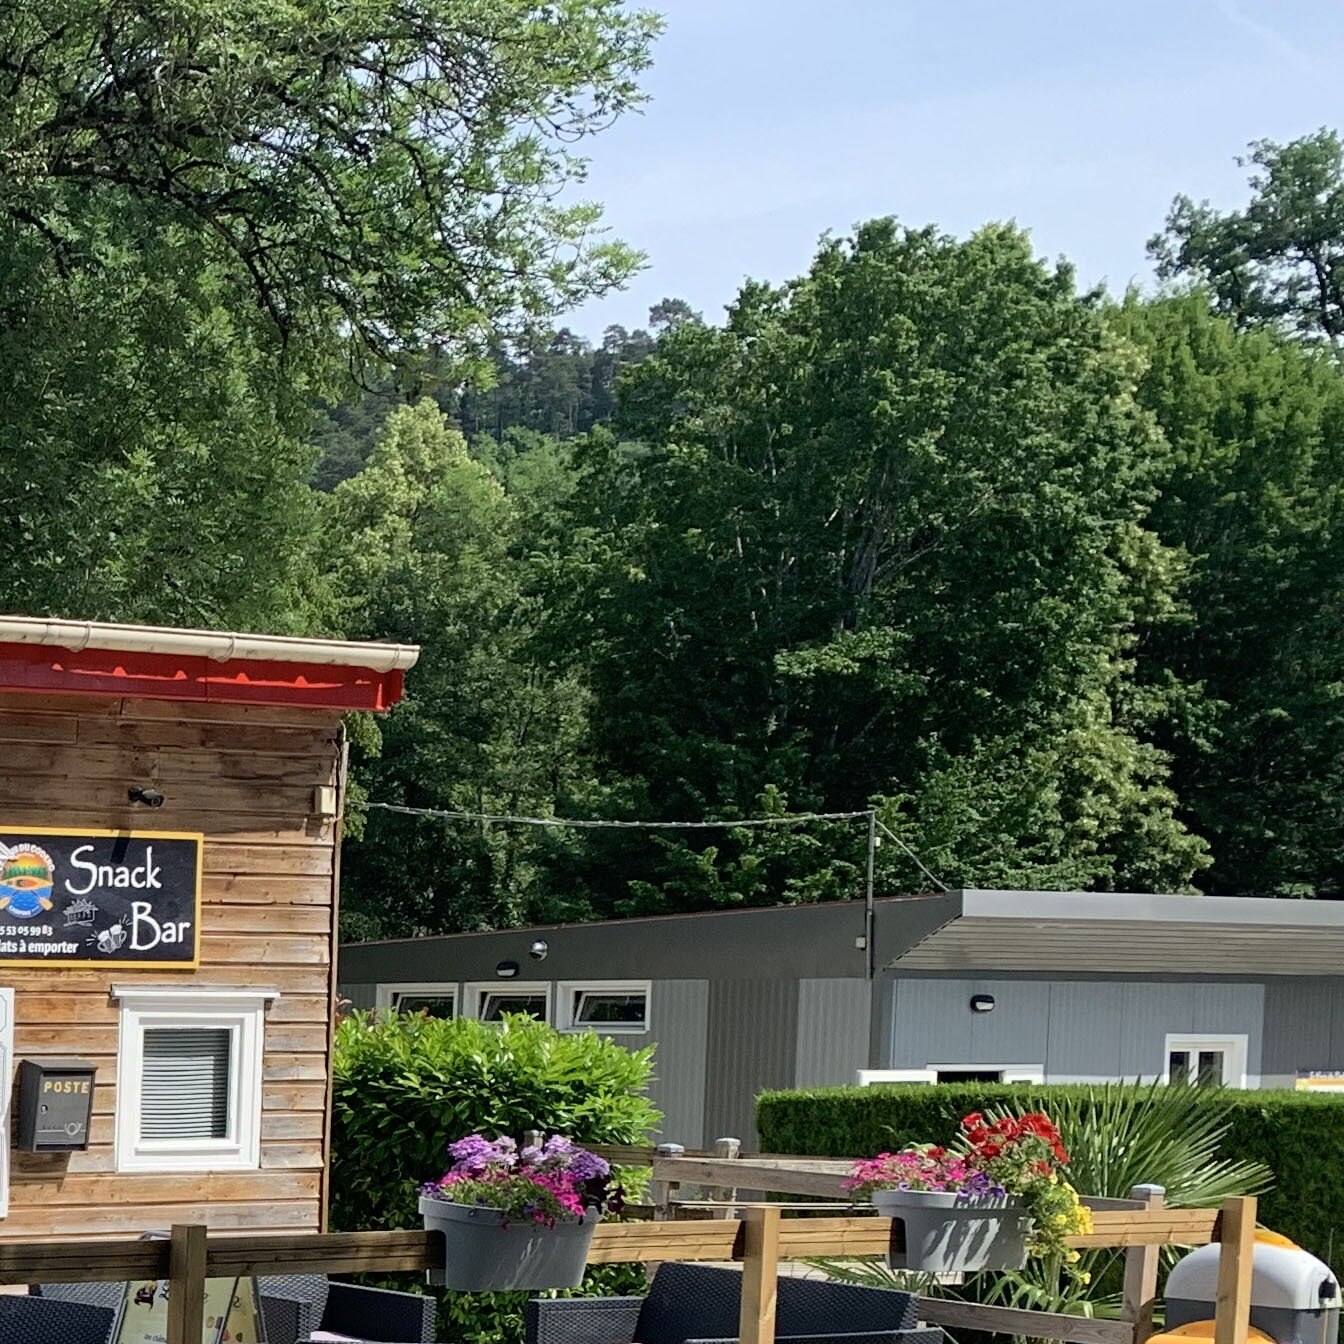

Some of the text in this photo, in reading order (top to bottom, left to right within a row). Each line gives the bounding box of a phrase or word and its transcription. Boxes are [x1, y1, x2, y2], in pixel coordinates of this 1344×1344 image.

[65, 845, 162, 895] Snack
[6, 926, 17, 936] 53
[18, 926, 29, 935] 05
[30, 926, 41, 936] 99
[42, 925, 53, 936] 83
[129, 901, 191, 951] Bar
[19, 940, 26, 952] à
[28, 941, 79, 956] emporter
[43, 1080, 89, 1094] POSTE
